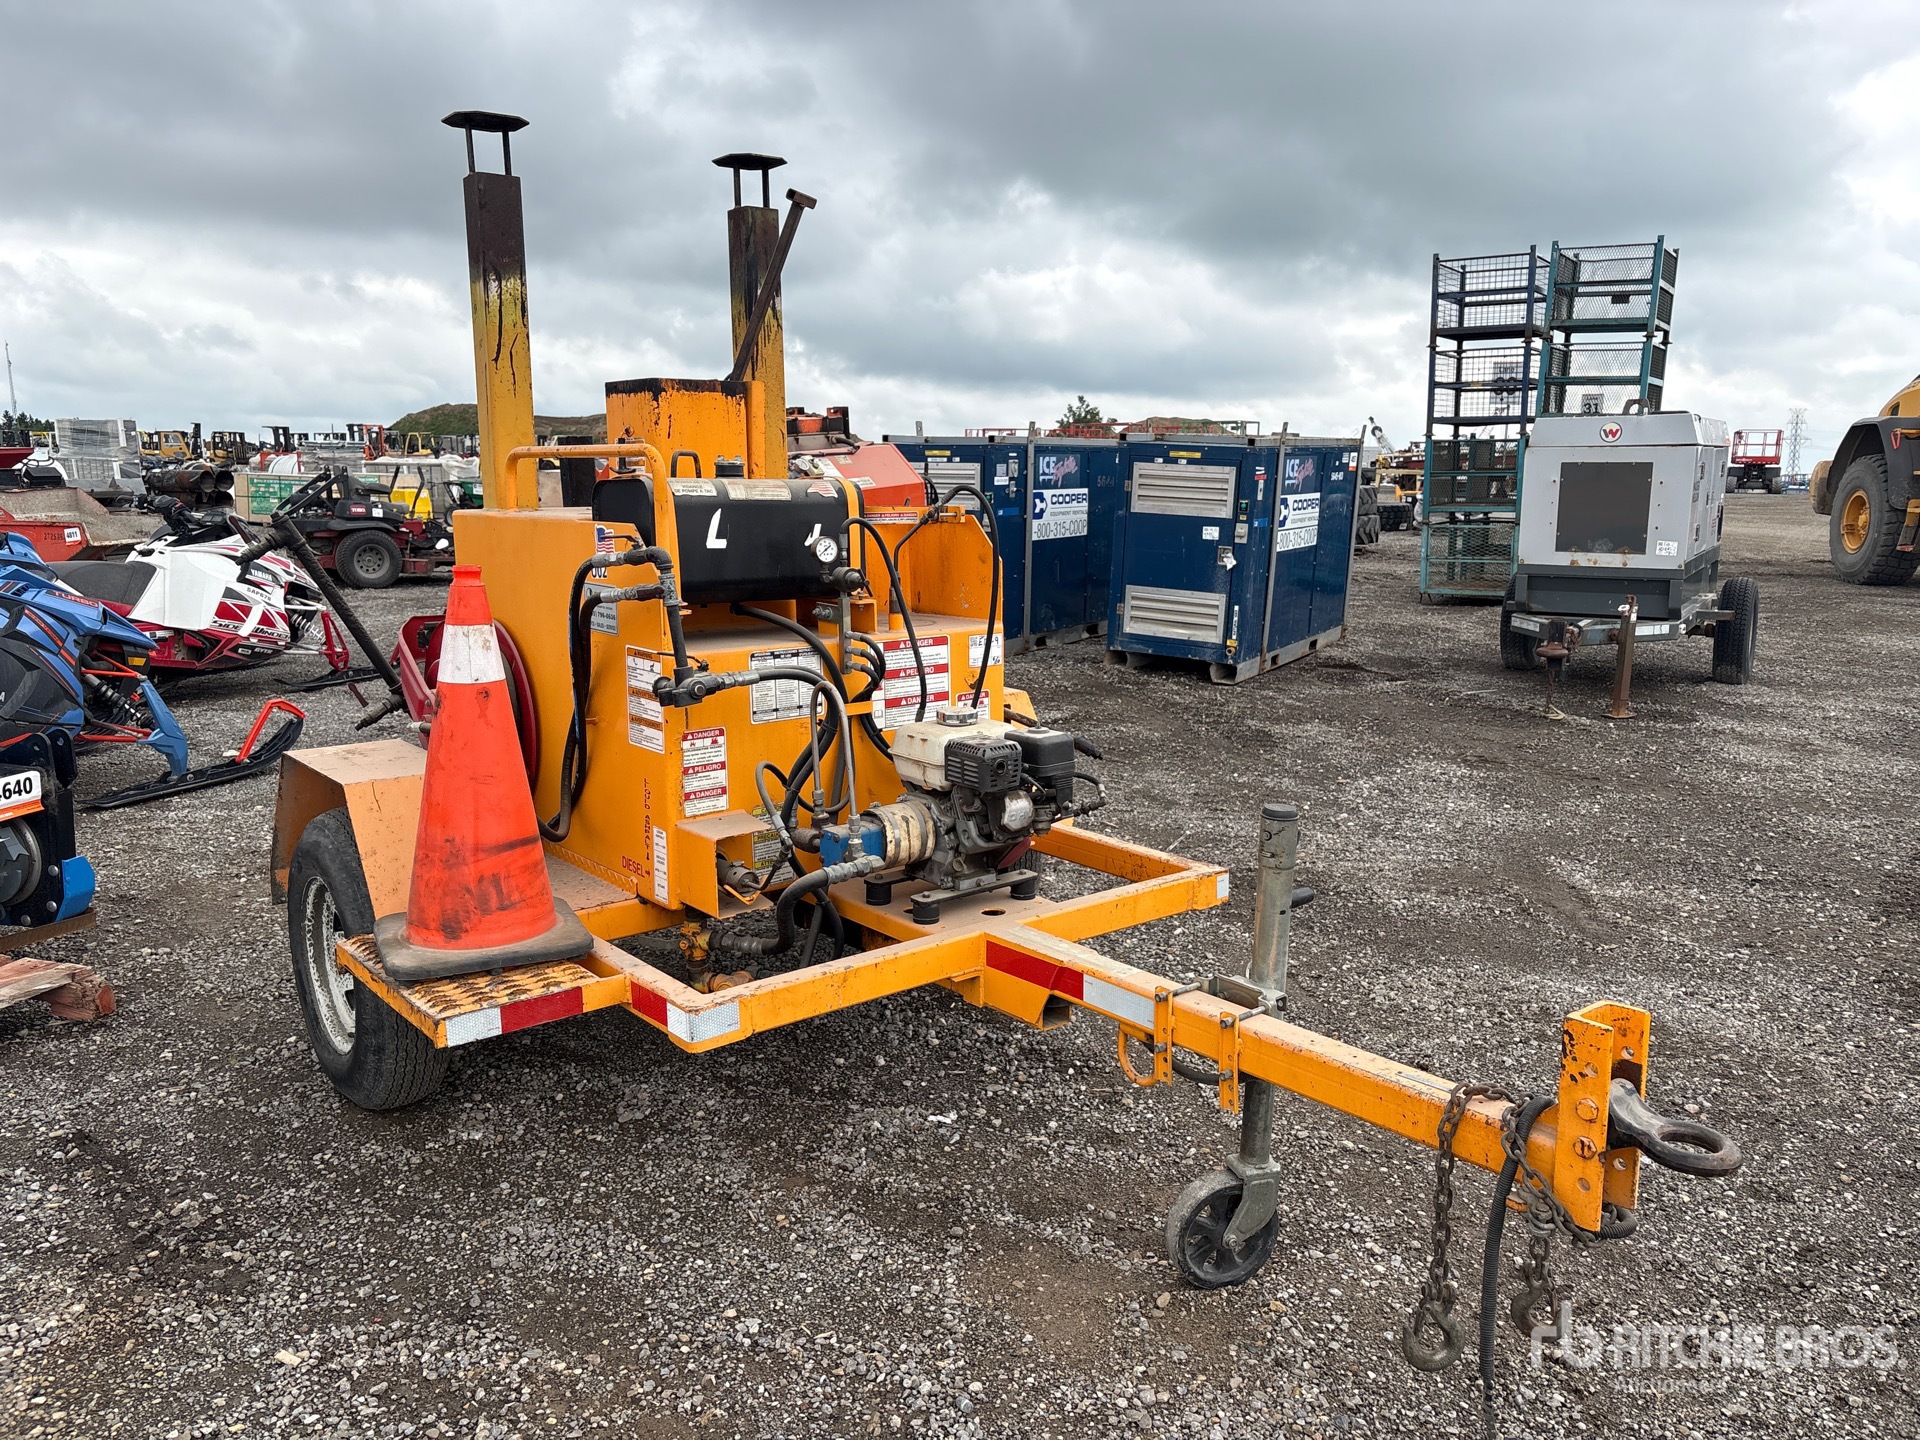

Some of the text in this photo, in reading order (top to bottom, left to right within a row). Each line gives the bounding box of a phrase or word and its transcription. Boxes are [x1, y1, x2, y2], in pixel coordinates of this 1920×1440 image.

[1039, 456, 1056, 475] ICE
[1285, 458, 1300, 478] ICE
[1050, 493, 1087, 505] COOPER
[1292, 498, 1319, 511] COOPER
[250, 569, 273, 581] YAMAHA
[53, 590, 98, 608] TURBO
[906, 638, 934, 648] DNGER
[906, 667, 935, 676] PELRO
[635, 690, 657, 700] ADVERTENC
[907, 695, 935, 704] DANER
[693, 730, 720, 739] DANGER
[694, 763, 721, 773] PELIGRO
[0, 777, 33, 800] 640
[695, 788, 722, 798] DANGER
[757, 832, 780, 841] PRECAU
[621, 856, 645, 878] DIESEL
